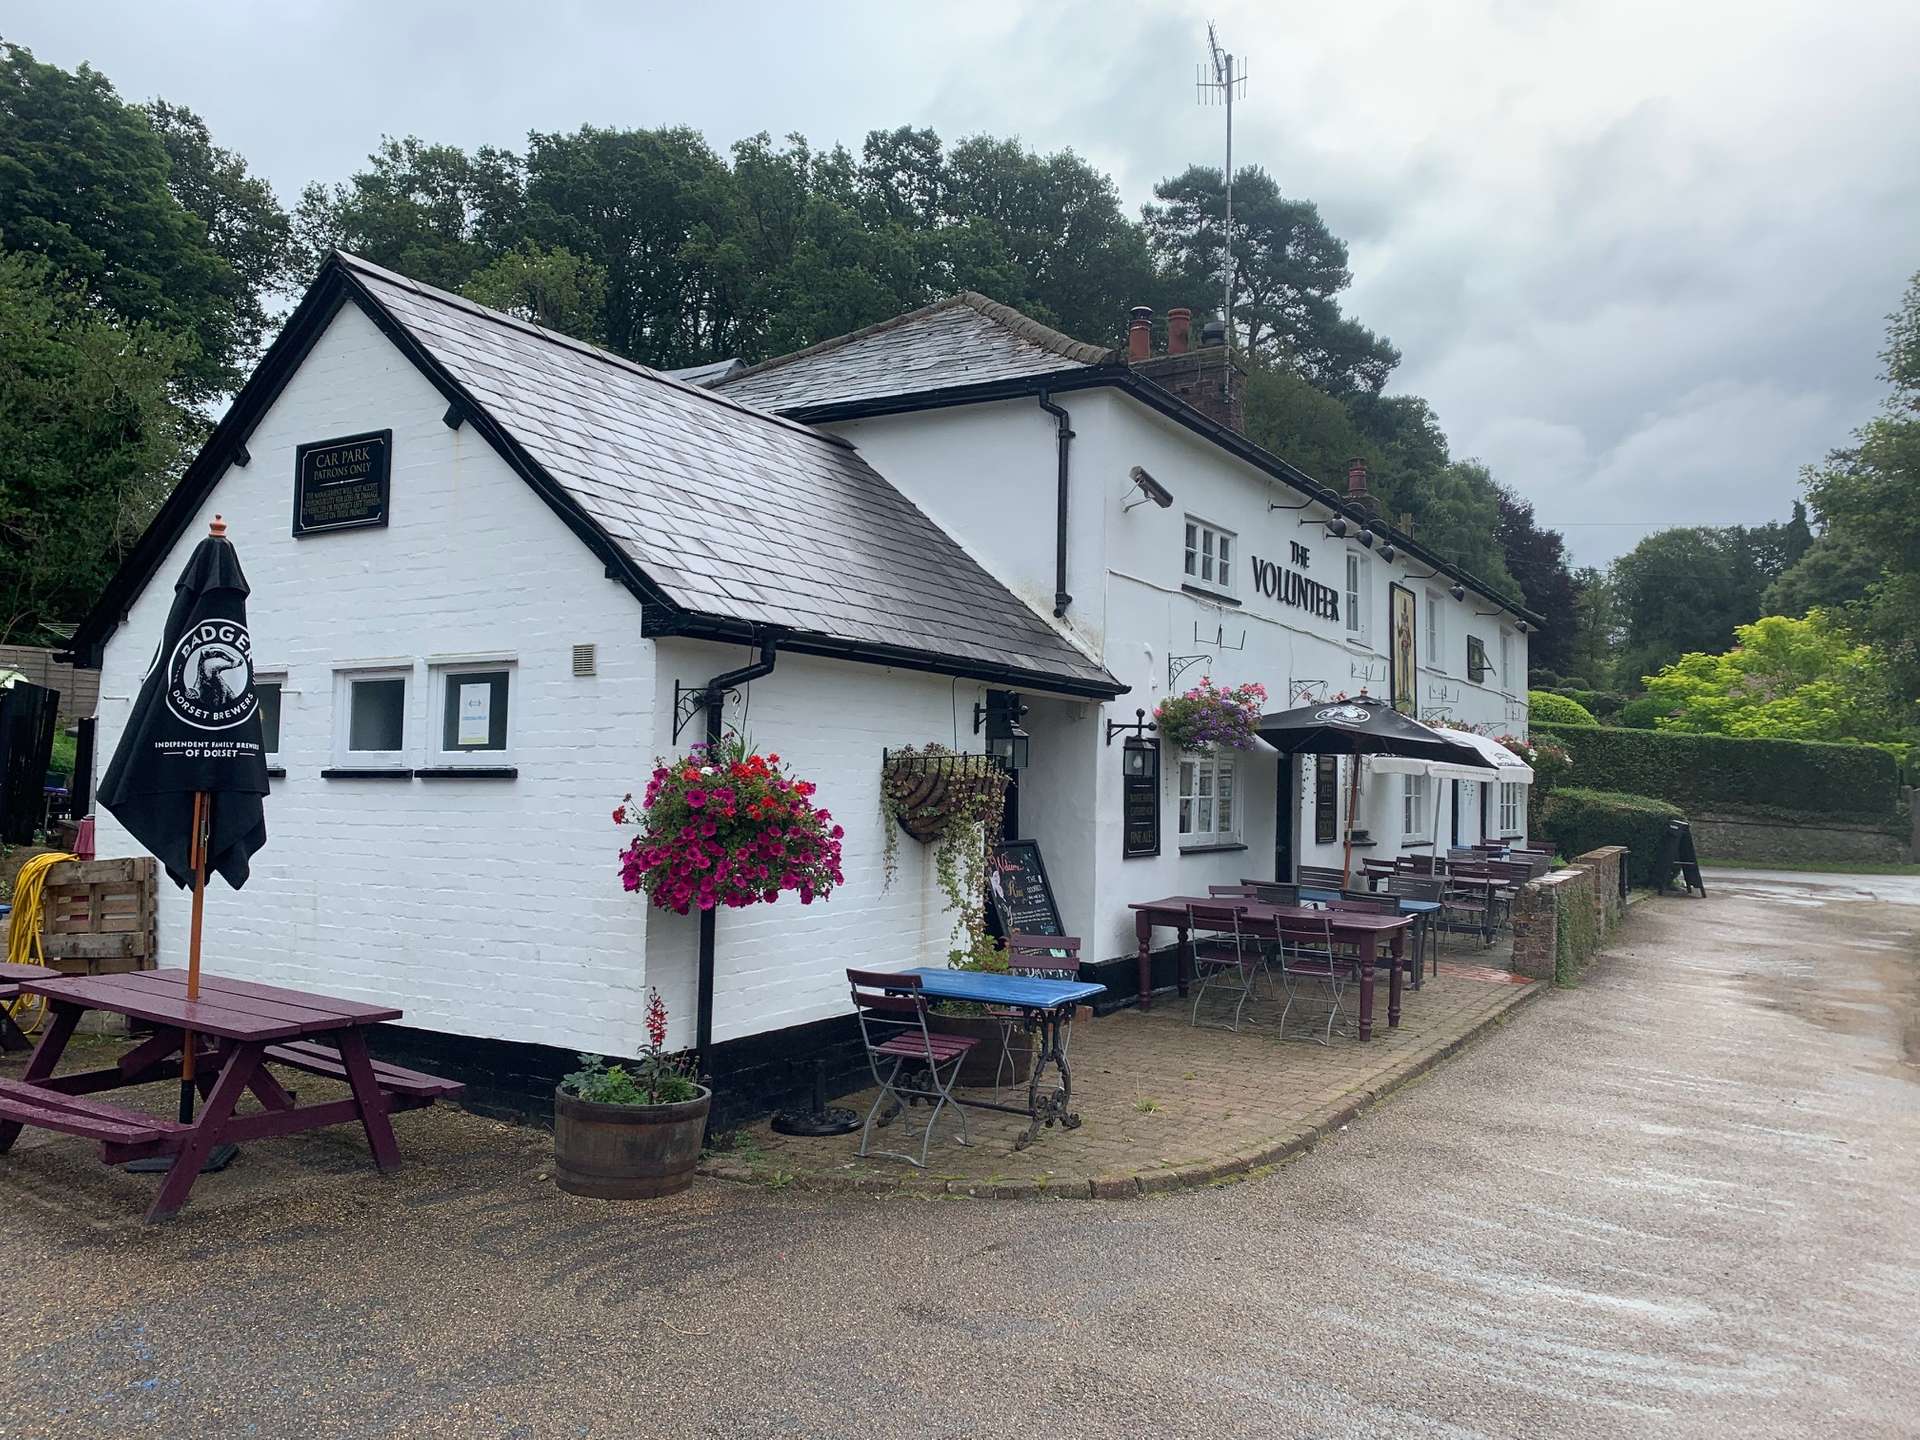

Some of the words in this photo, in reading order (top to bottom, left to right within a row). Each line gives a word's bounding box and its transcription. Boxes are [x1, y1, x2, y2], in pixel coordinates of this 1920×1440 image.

[317, 454, 338, 468] CAR
[342, 447, 370, 464] PARK
[314, 467, 349, 481] PATRONS
[349, 462, 372, 475] ONLY
[1289, 540, 1310, 569] THE
[1251, 555, 1340, 621] VOLUNTEER
[172, 689, 210, 720] DORSET
[212, 693, 254, 721] BREWERS
[154, 740, 210, 749] INDEPENDENT
[211, 741, 235, 749] FAMILY
[185, 749, 201, 758] OF
[203, 749, 239, 758] DORSET
